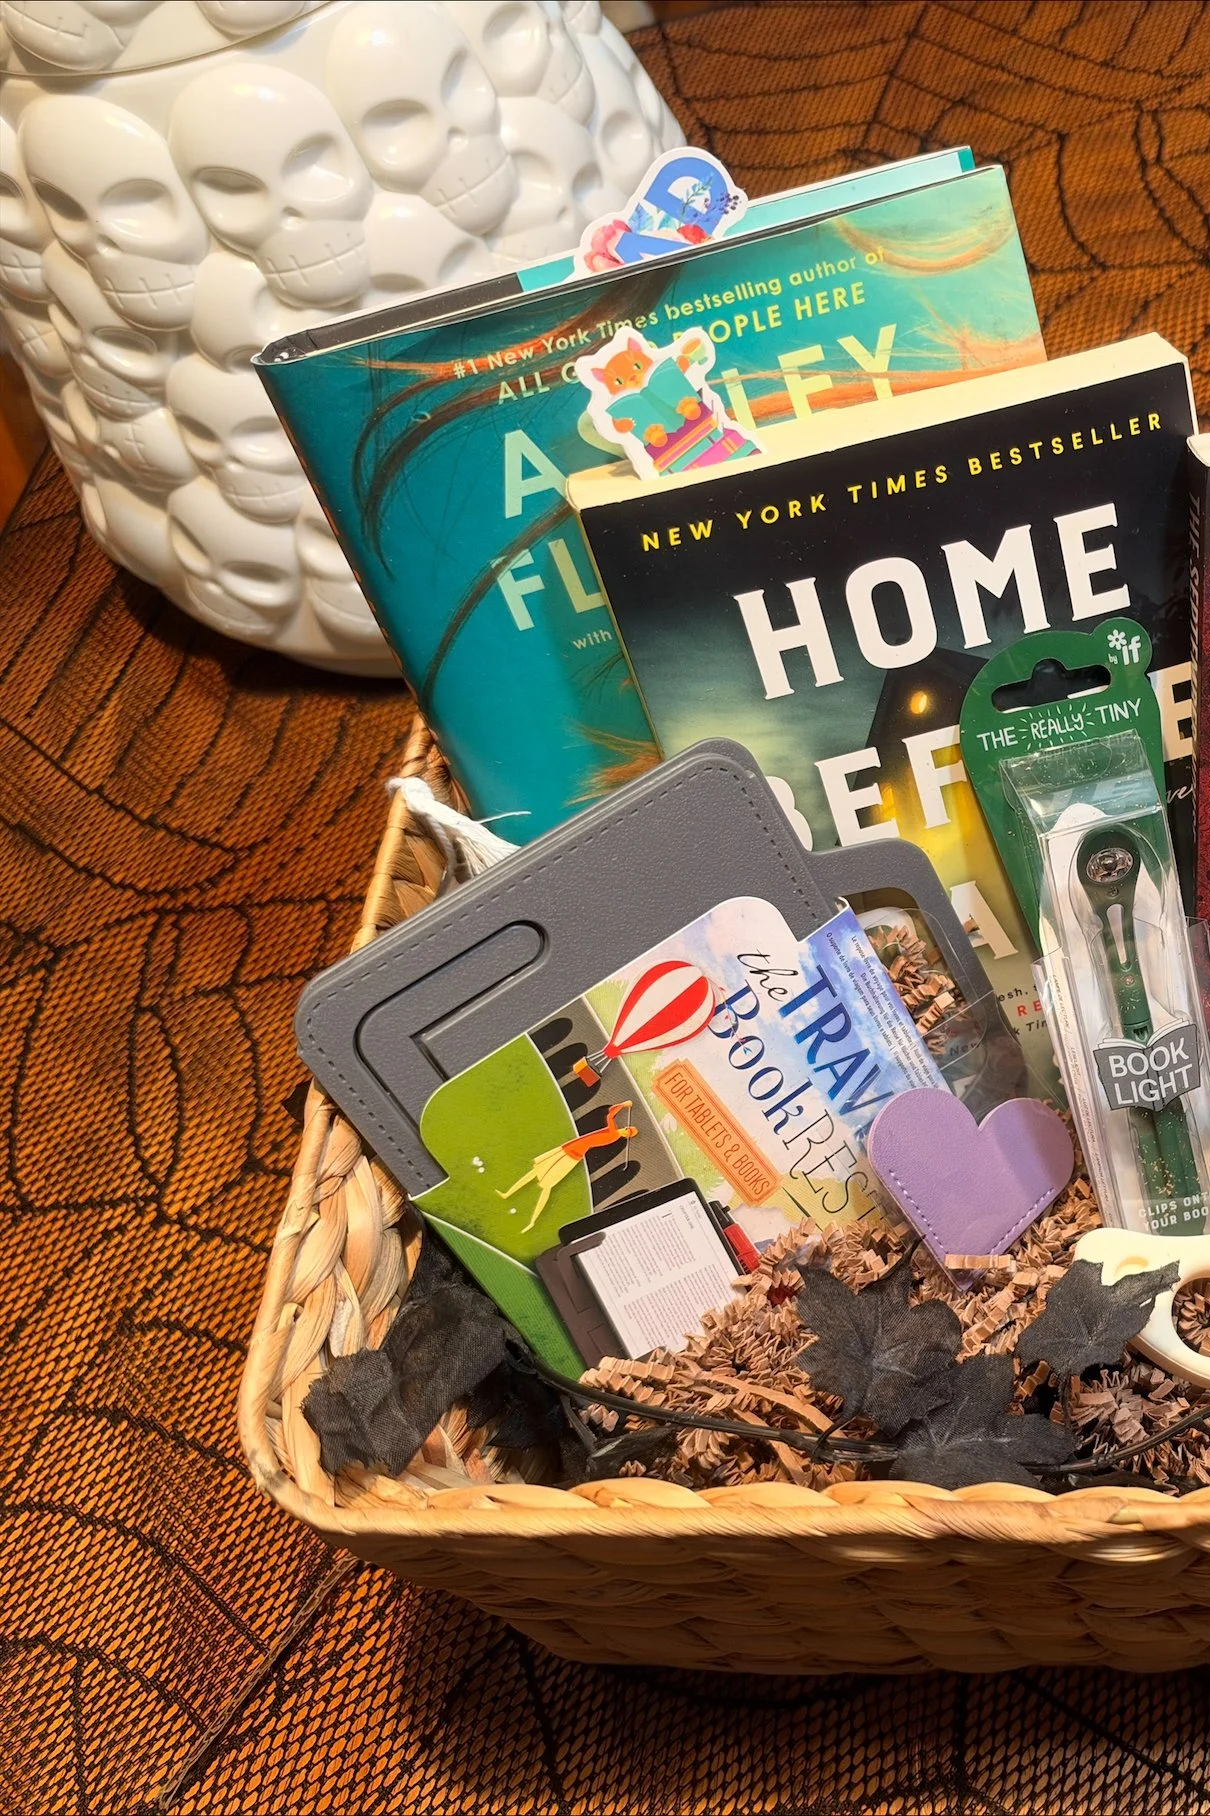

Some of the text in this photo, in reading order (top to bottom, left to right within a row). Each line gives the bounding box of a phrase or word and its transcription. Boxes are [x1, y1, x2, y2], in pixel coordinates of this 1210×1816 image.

[453, 247, 886, 380] #1 New York Times bestselling author of
[498, 282, 867, 406] ALL OPLE HERE
[642, 412, 1162, 552] NEW YORK TIMES BESTSELLER
[733, 502, 1131, 700] HOME
[572, 629, 612, 650] with
[1108, 653, 1118, 665] by
[976, 698, 1141, 751] THE REALLY TINY
[827, 936, 842, 956] suporte
[848, 971, 855, 979] de
[870, 973, 885, 992] voyage
[737, 949, 895, 1118] the TRAV
[1108, 1037, 1189, 1078] BOOK
[1114, 1063, 1193, 1105] LIGHT
[663, 1070, 771, 1196] FOR TABLETS & BOOKS
[1138, 1200, 1177, 1218] CLIPS
[1143, 1215, 1178, 1231] YOUR
